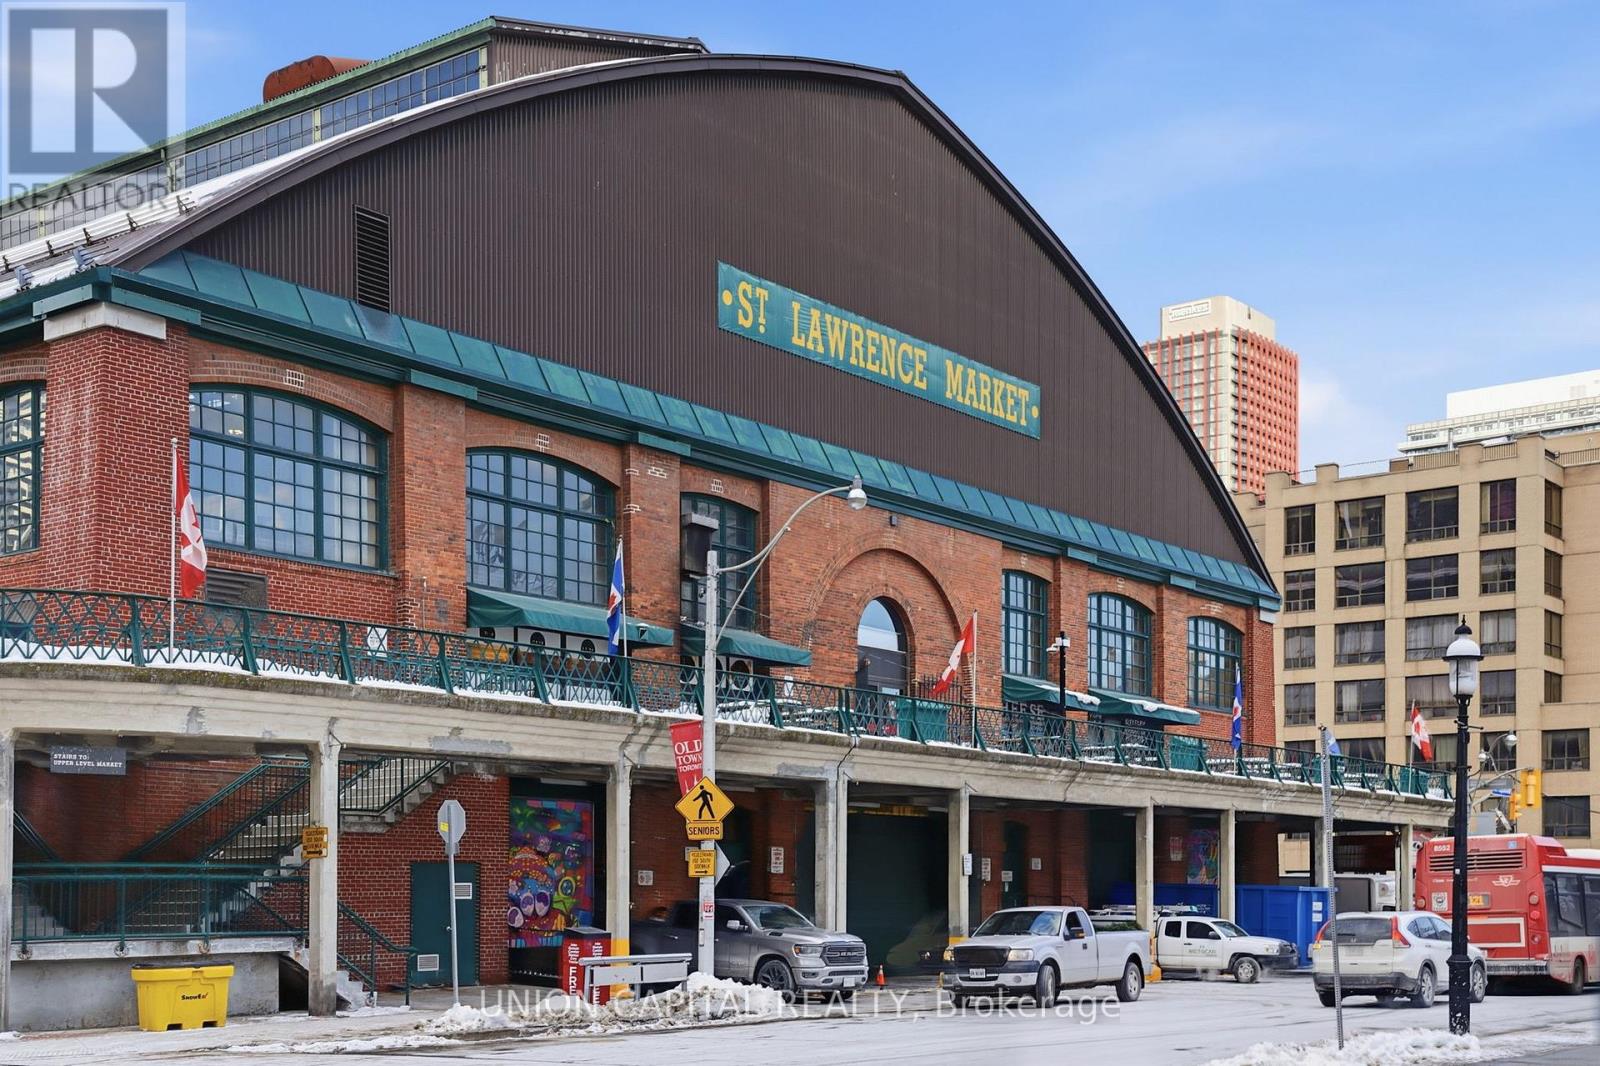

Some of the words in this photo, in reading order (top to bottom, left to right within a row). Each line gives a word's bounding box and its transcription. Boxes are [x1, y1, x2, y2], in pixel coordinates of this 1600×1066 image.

[791, 301, 927, 390] LAWRENCE
[945, 360, 1029, 427] MARKET
[675, 740, 702, 755] OLD
[677, 753, 702, 766] TOWN
[688, 826, 720, 835] SENIORS
